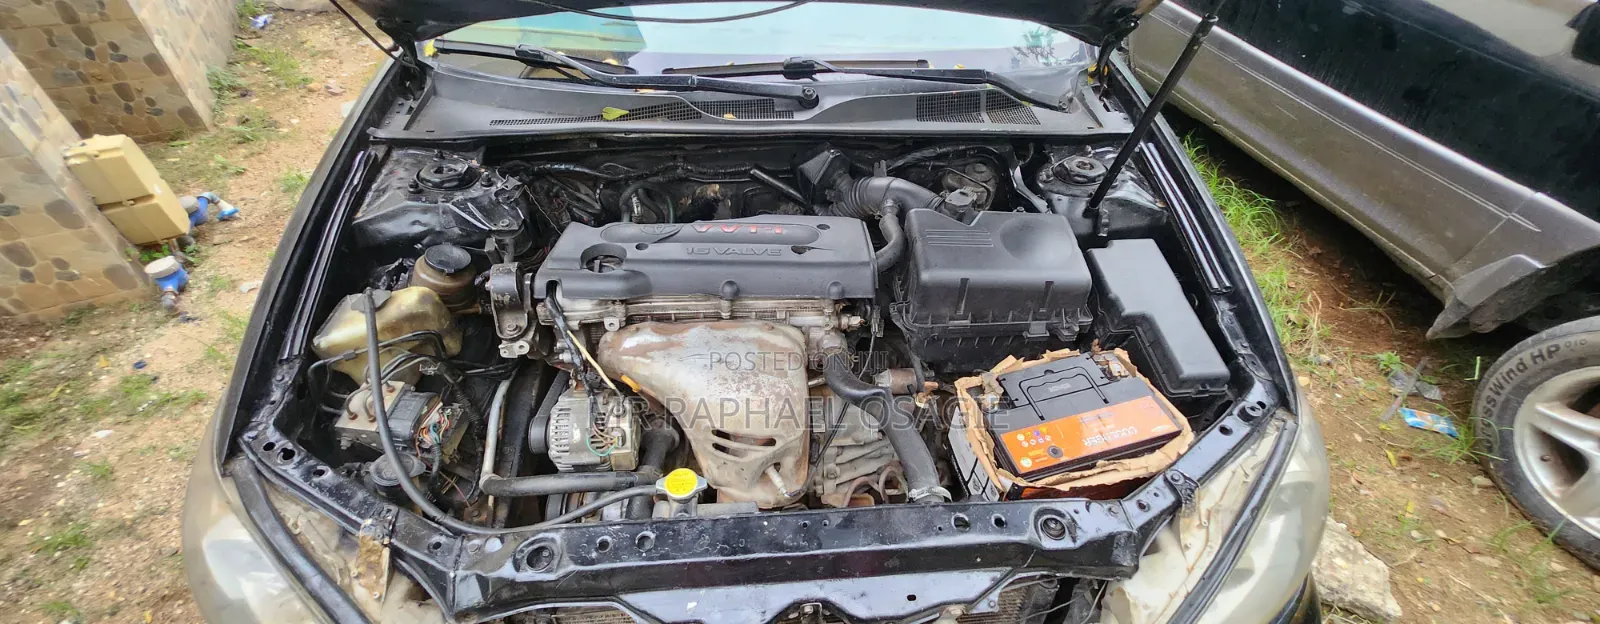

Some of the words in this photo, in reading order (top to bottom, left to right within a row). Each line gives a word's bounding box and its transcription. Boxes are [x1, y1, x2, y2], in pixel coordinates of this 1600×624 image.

[687, 247, 710, 255] 16
[713, 247, 782, 256] VALVE
[1530, 343, 1561, 365] HP
